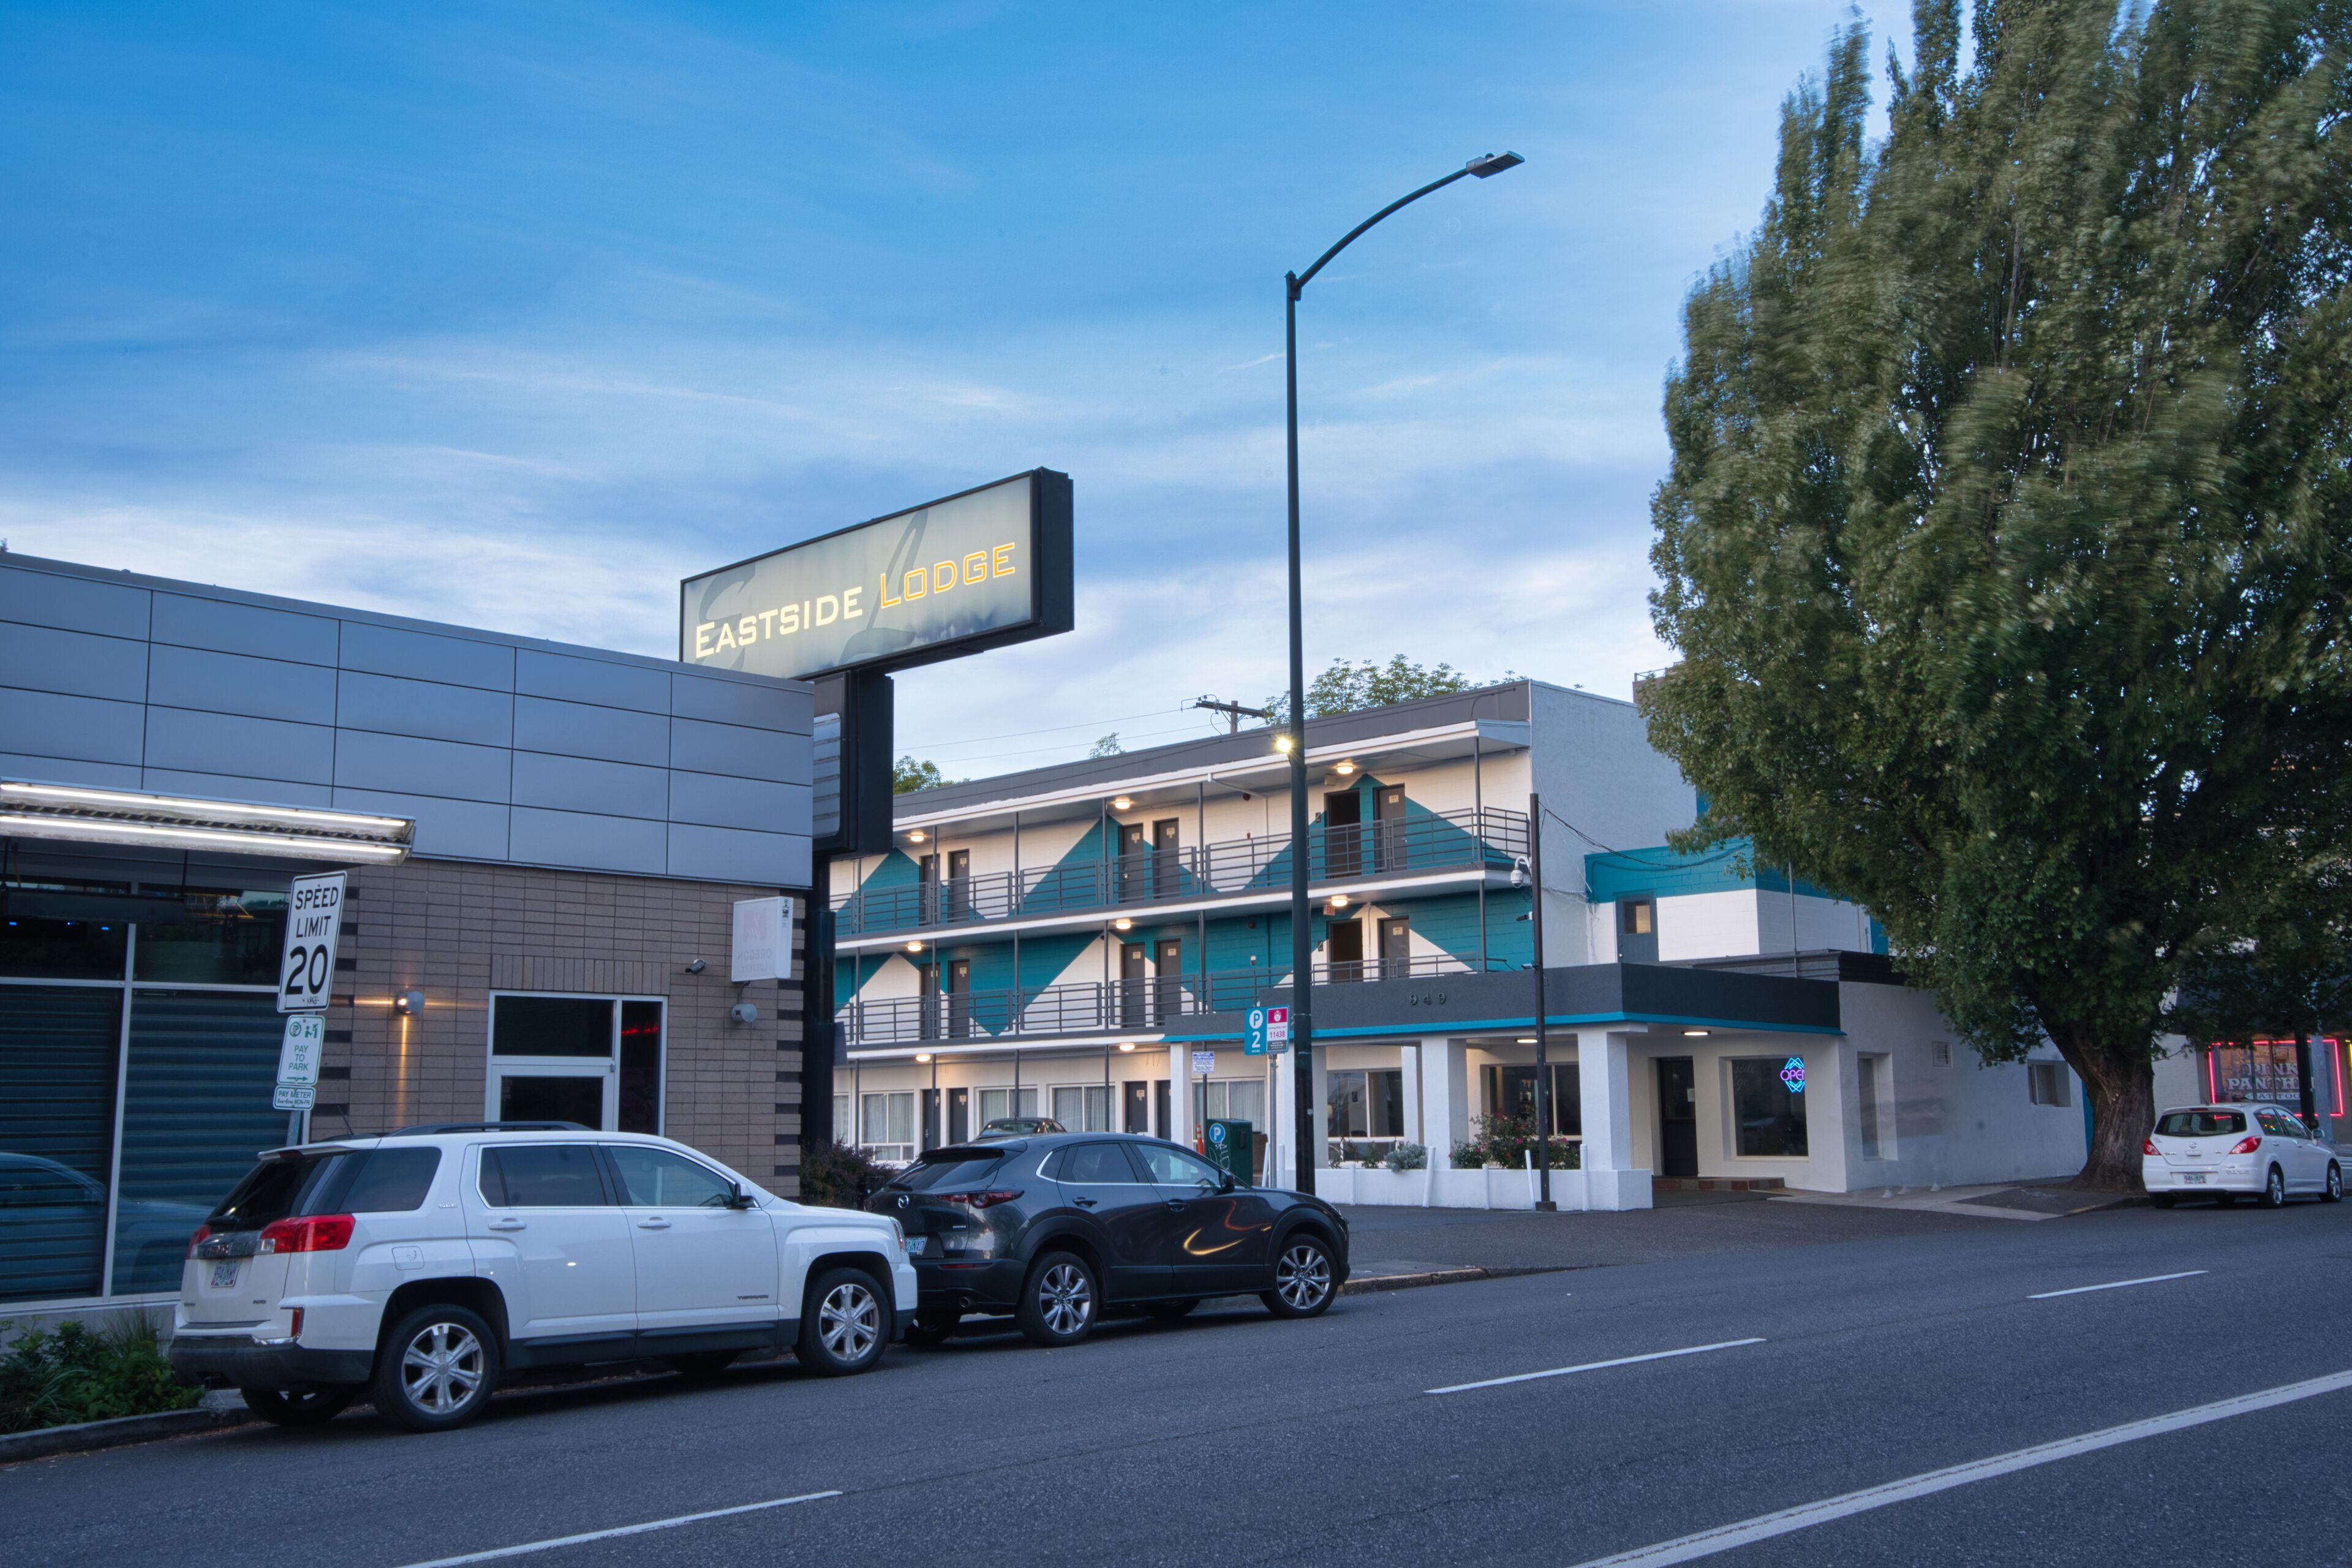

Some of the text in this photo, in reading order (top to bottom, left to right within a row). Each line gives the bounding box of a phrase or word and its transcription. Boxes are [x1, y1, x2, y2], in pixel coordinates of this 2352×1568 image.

[696, 542, 1016, 658] EASTSIDE LODGE
[295, 886, 339, 910] SPEED
[296, 916, 331, 938] LIMIT
[285, 944, 328, 995] 20
[1409, 992, 1446, 1006] 949
[1253, 1013, 1260, 1026] P
[1251, 1031, 1261, 1048] 2
[2247, 1063, 2297, 1076] PINK
[1213, 1126, 1221, 1140] P
